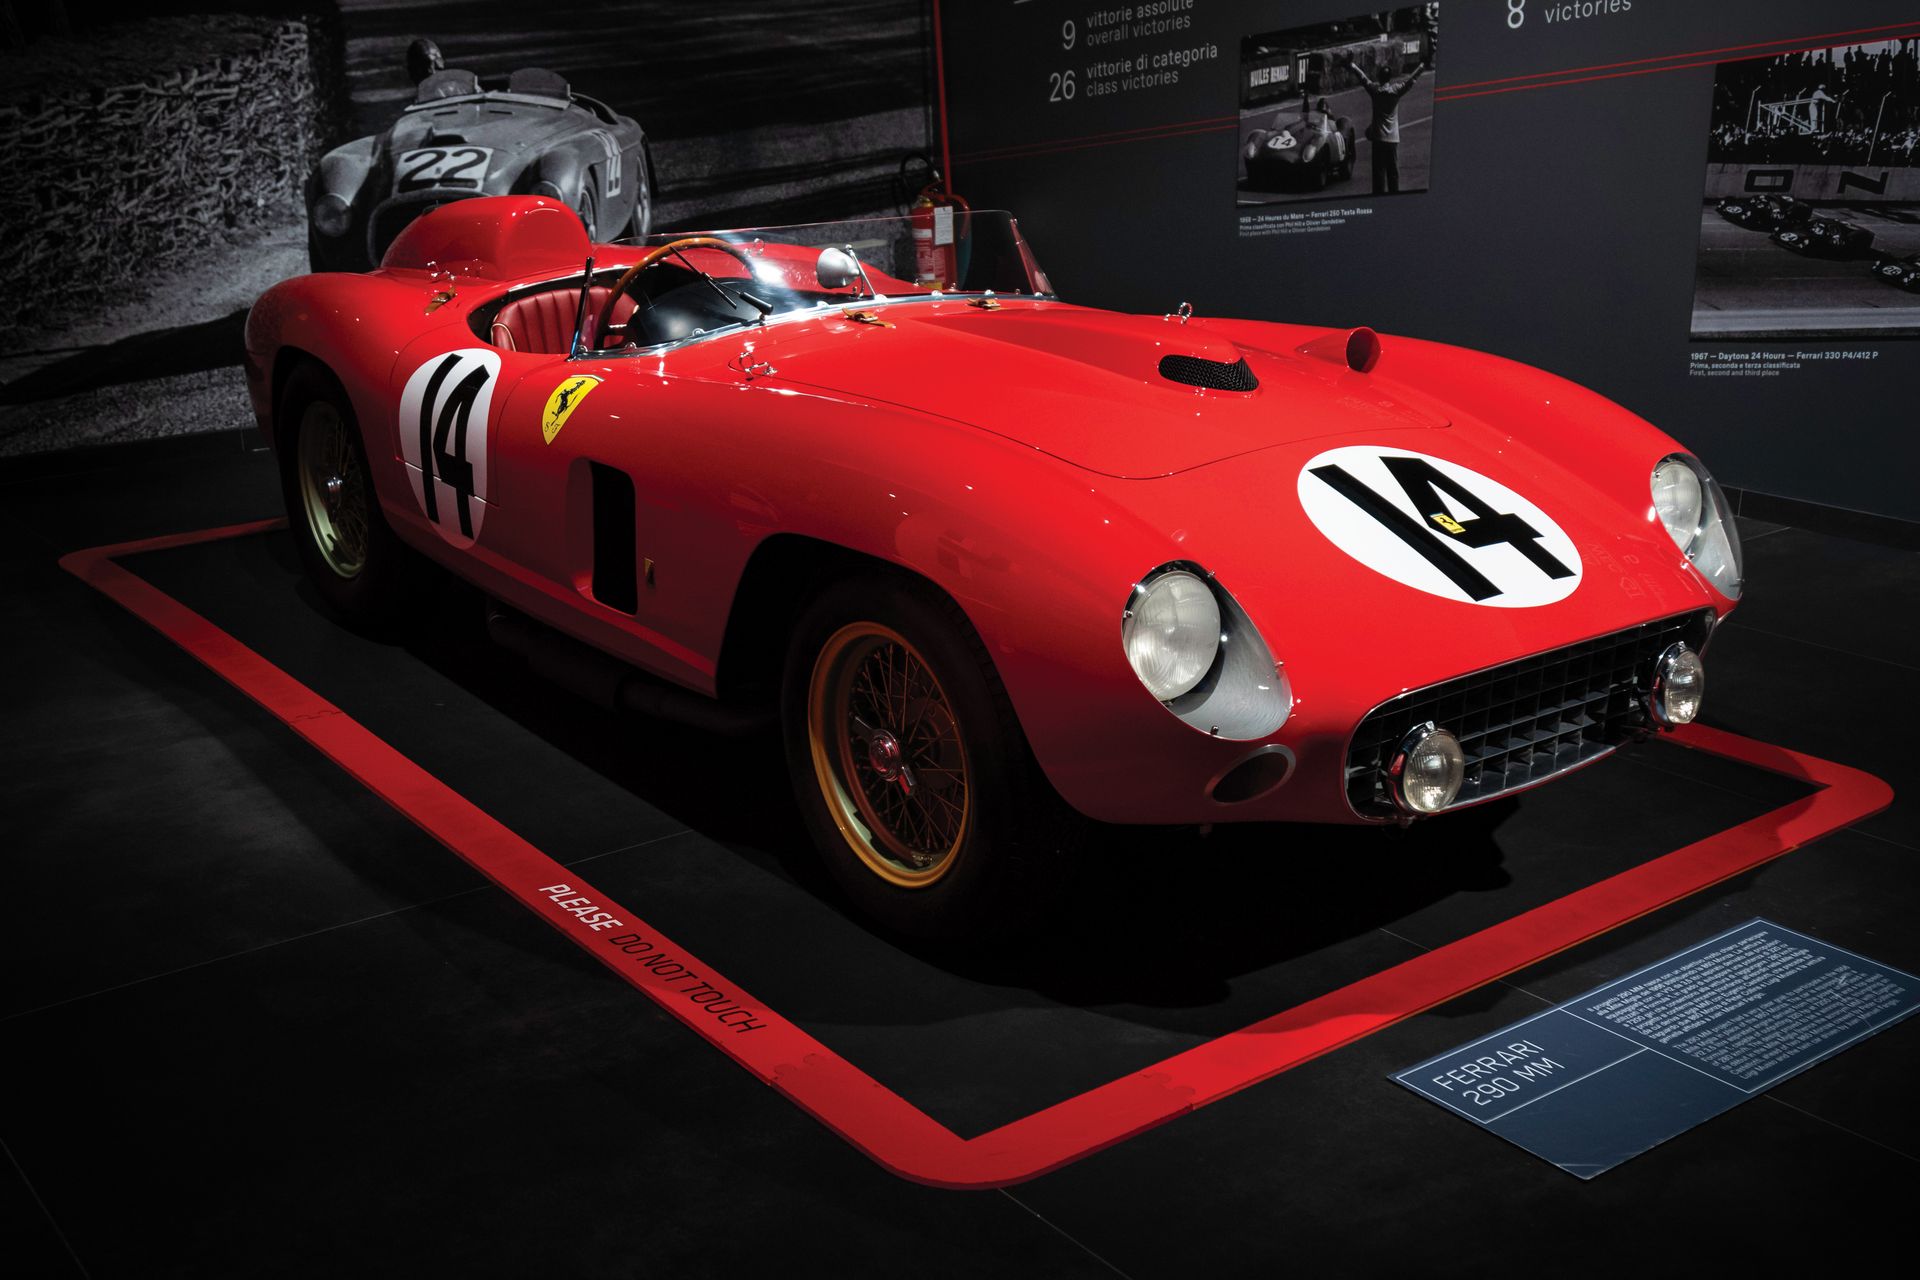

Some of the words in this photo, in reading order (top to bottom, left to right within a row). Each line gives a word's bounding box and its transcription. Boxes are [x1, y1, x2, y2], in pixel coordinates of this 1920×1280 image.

[1063, 20, 1076, 50] 9
[1086, 6, 1133, 28] vittorie
[1136, 0, 1194, 19] assolute
[1087, 24, 1129, 47] overall
[1132, 14, 1192, 38] victories
[1507, 0, 1526, 29] 8
[1544, 0, 1632, 24] victories
[1050, 70, 1076, 102] 26
[1086, 57, 1132, 80] vittorie
[1136, 54, 1149, 70] di
[1153, 42, 1218, 68] categoria
[1086, 79, 1118, 97] class
[1122, 70, 1180, 92] victories
[398, 148, 488, 193] 22
[1718, 352, 1750, 361] Daytona
[1796, 352, 1824, 360] Ferrari
[1842, 352, 1870, 360] P4/412
[420, 353, 490, 540] 14
[1307, 456, 1577, 602] 14
[538, 884, 624, 932] PLEASE
[608, 933, 653, 954] DO
[641, 953, 698, 982] NOT
[680, 981, 768, 1034] TOUCH
[1432, 1040, 1545, 1090] FERRARI
[1462, 1077, 1520, 1106] 290
[1514, 1057, 1565, 1083] MM
